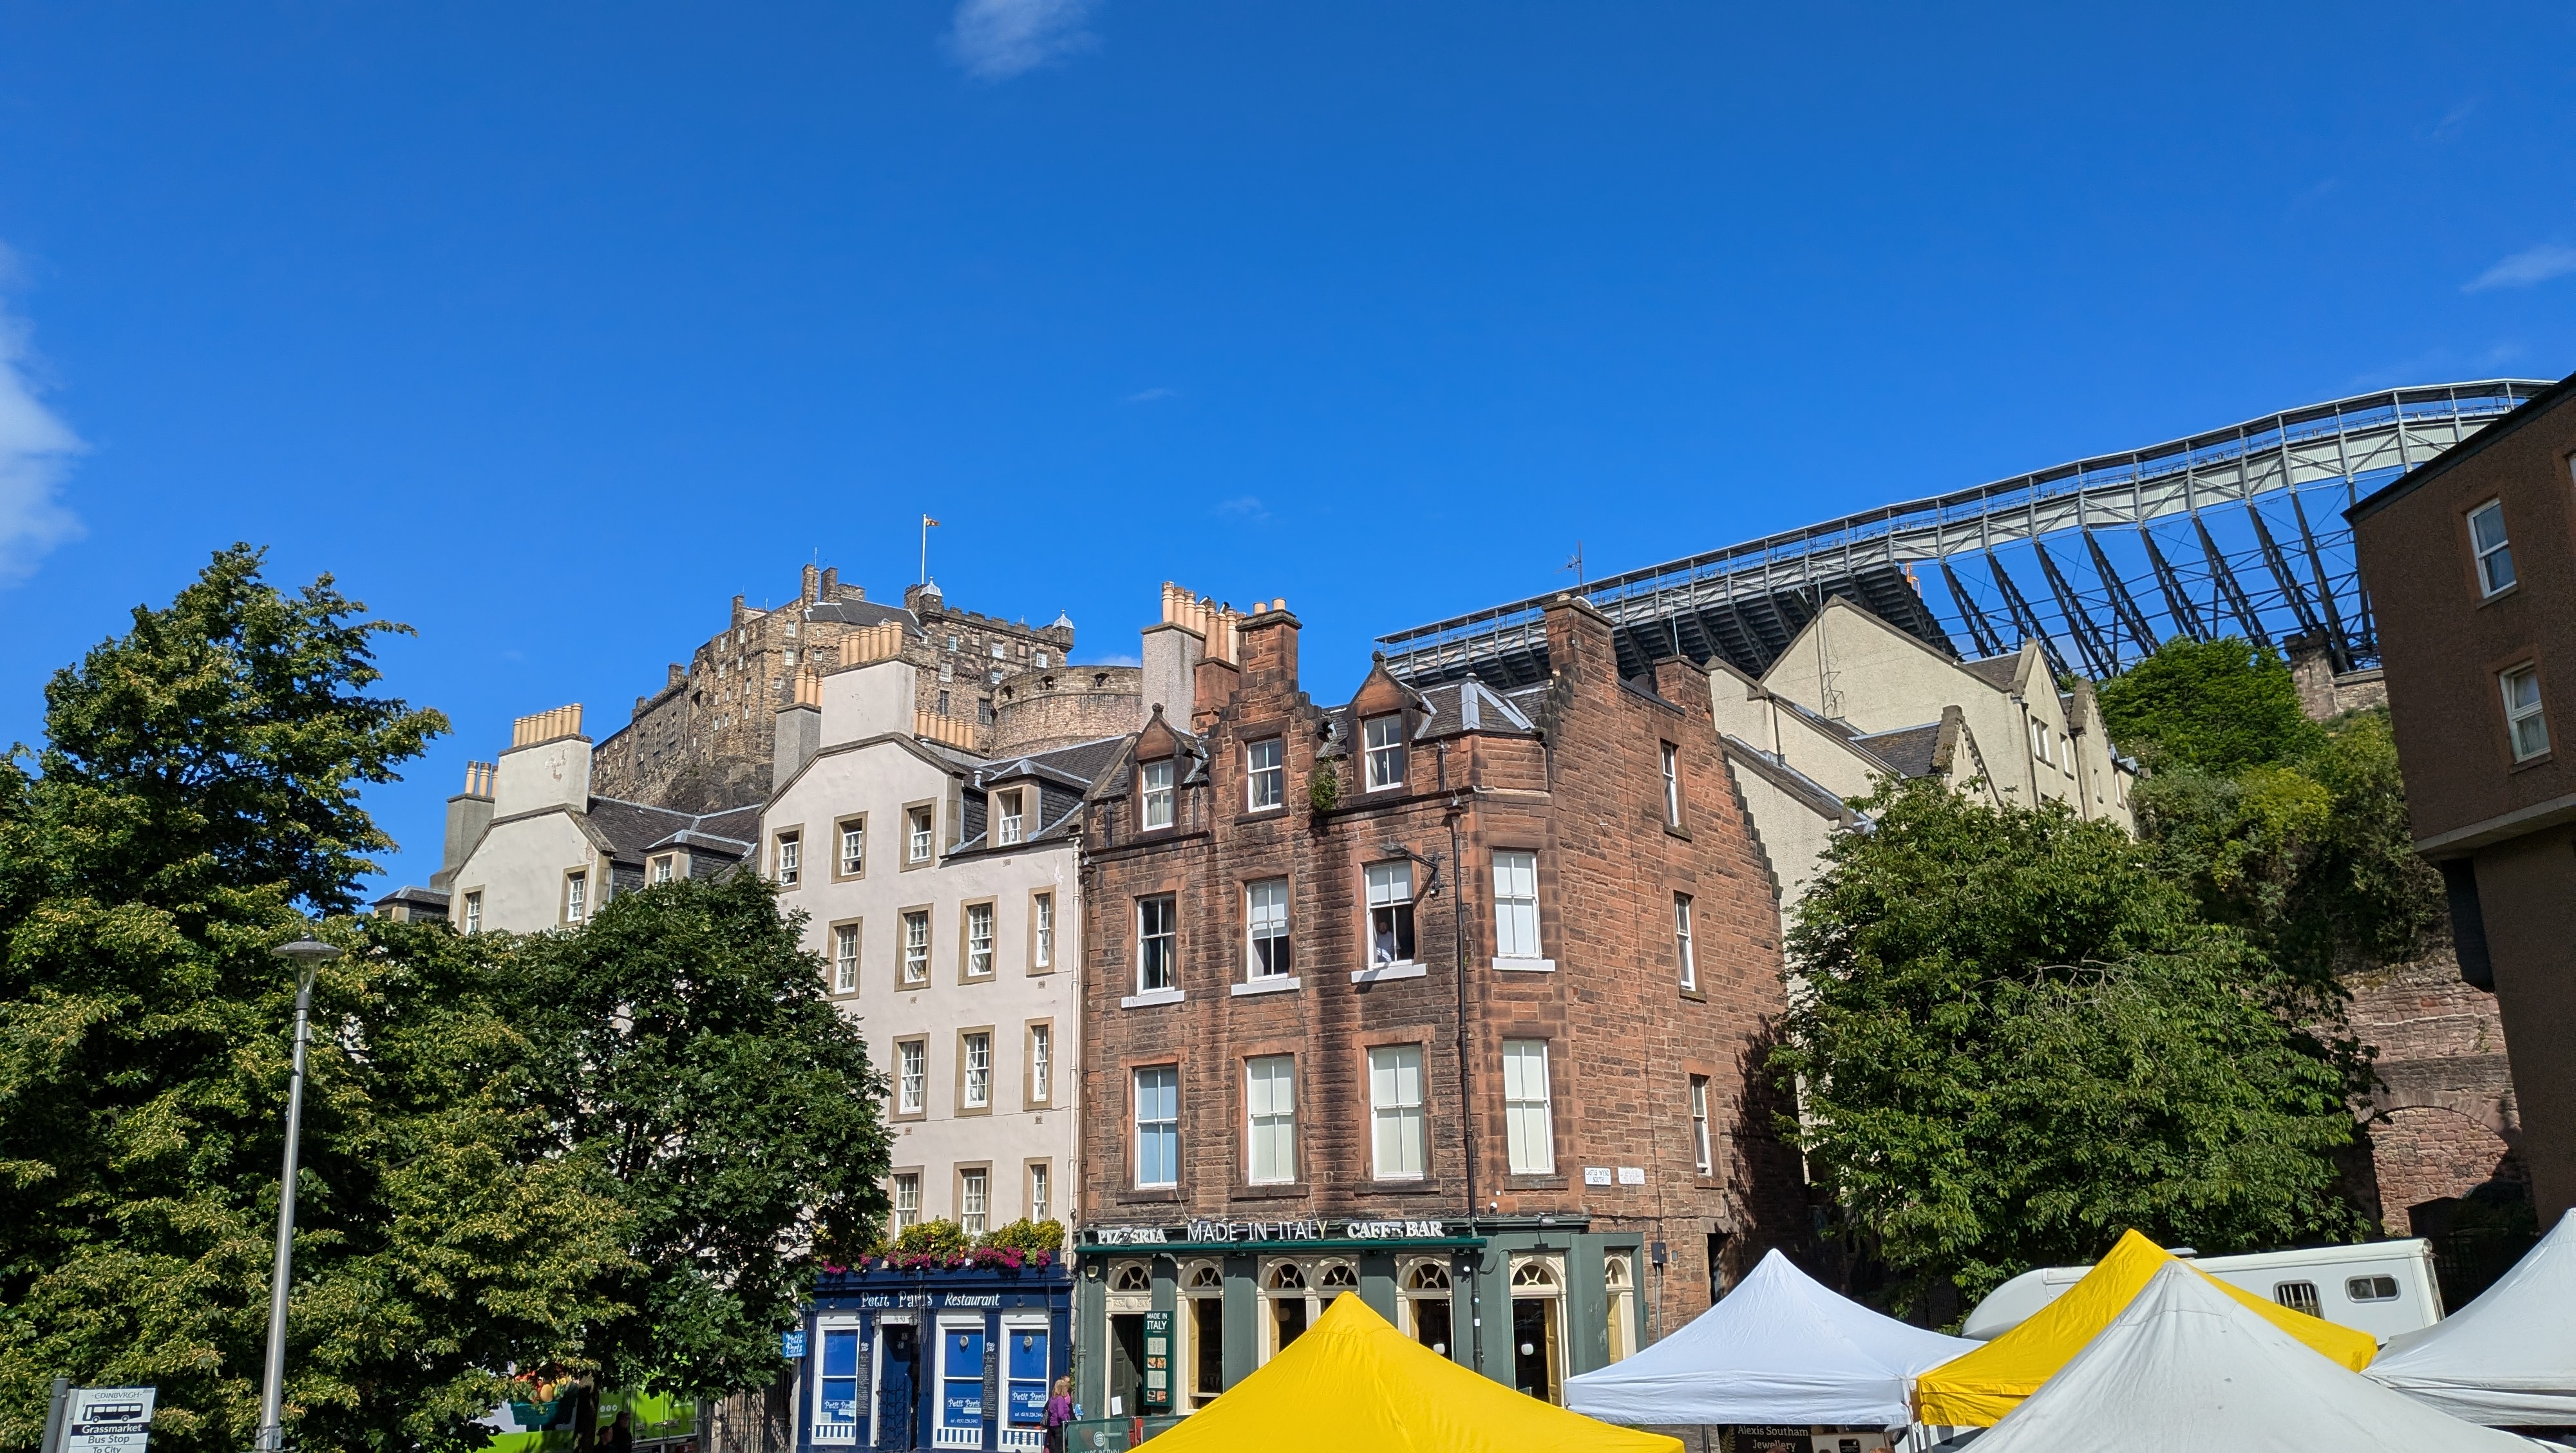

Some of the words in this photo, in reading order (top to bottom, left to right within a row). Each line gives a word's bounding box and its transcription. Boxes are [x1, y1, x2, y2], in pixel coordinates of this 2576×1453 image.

[1188, 1222, 1238, 1242] MADE
[1248, 1222, 1267, 1240] IN
[1278, 1220, 1328, 1240] ITALY
[1405, 1221, 1444, 1237] BAR
[860, 1292, 890, 1307] Petit
[898, 1291, 933, 1308] Paris
[944, 1292, 1001, 1306] Restaurant
[1147, 1320, 1167, 1330] ITALY
[786, 1334, 803, 1344] Petit
[786, 1342, 803, 1353] Paris
[1012, 1392, 1028, 1401] Petit
[948, 1398, 963, 1407] Petit
[82, 1423, 142, 1434] Grassmarket
[1738, 1425, 1765, 1435] Alexis
[1766, 1426, 1809, 1436] Southam
[88, 1436, 106, 1444] Bus
[108, 1435, 129, 1444] Stop
[1752, 1439, 1796, 1452] Jewellery
